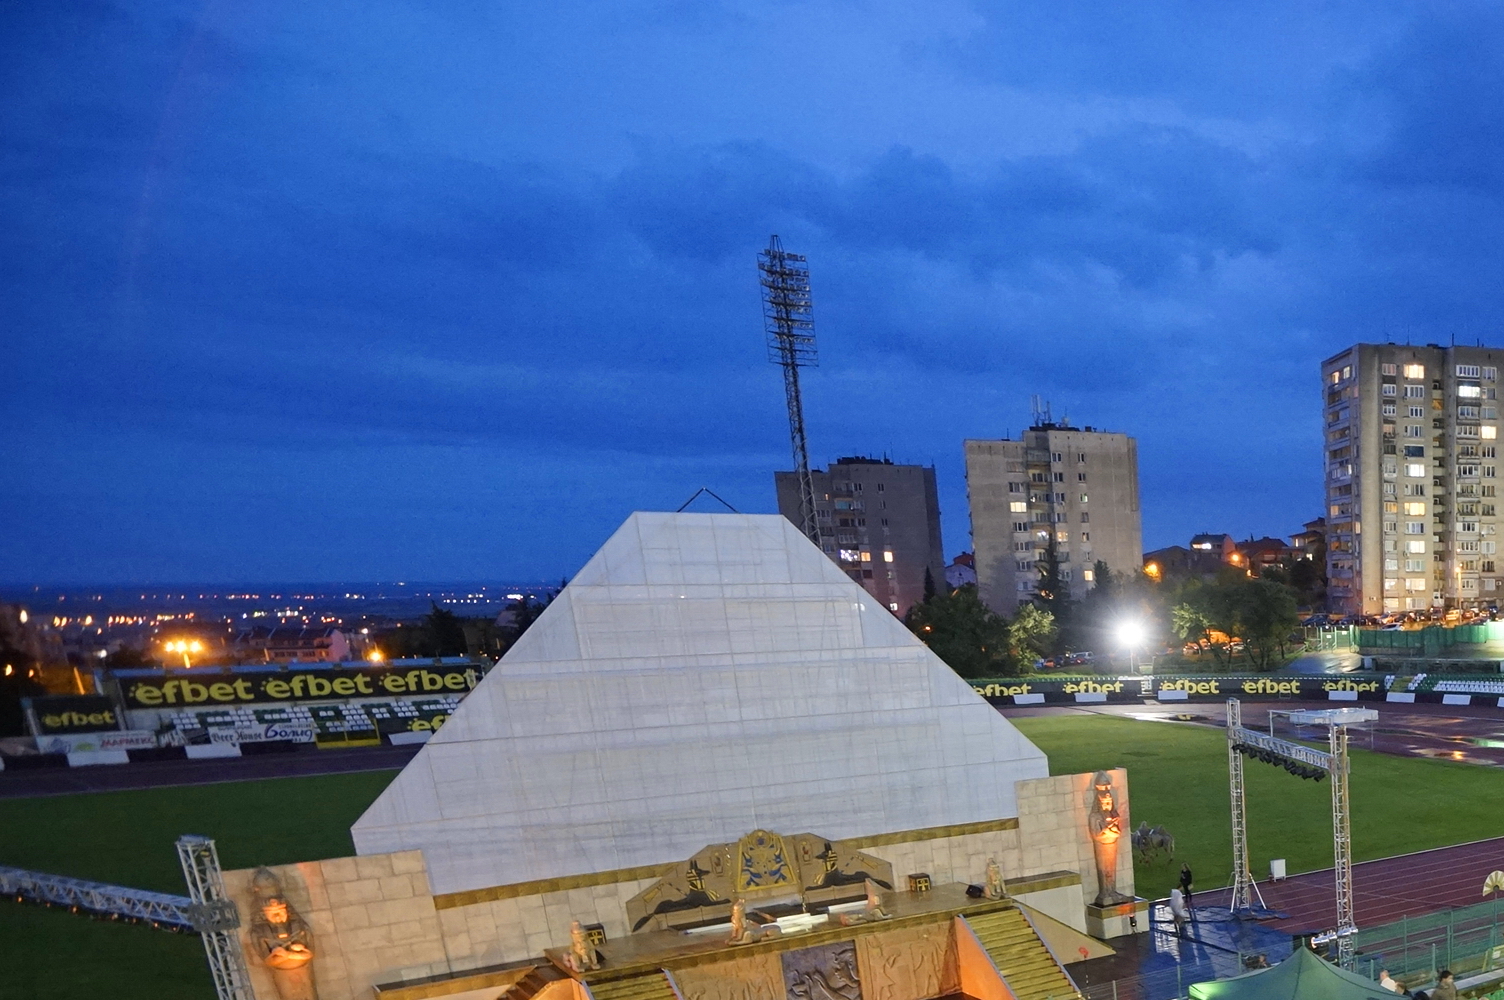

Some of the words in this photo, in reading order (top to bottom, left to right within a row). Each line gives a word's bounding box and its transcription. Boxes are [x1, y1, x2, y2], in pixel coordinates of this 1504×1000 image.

[131, 677, 255, 706] efbet
[262, 672, 374, 698] efbet
[1160, 679, 1220, 695] efbet
[1242, 679, 1300, 694] efbet
[43, 710, 116, 728] efbet
